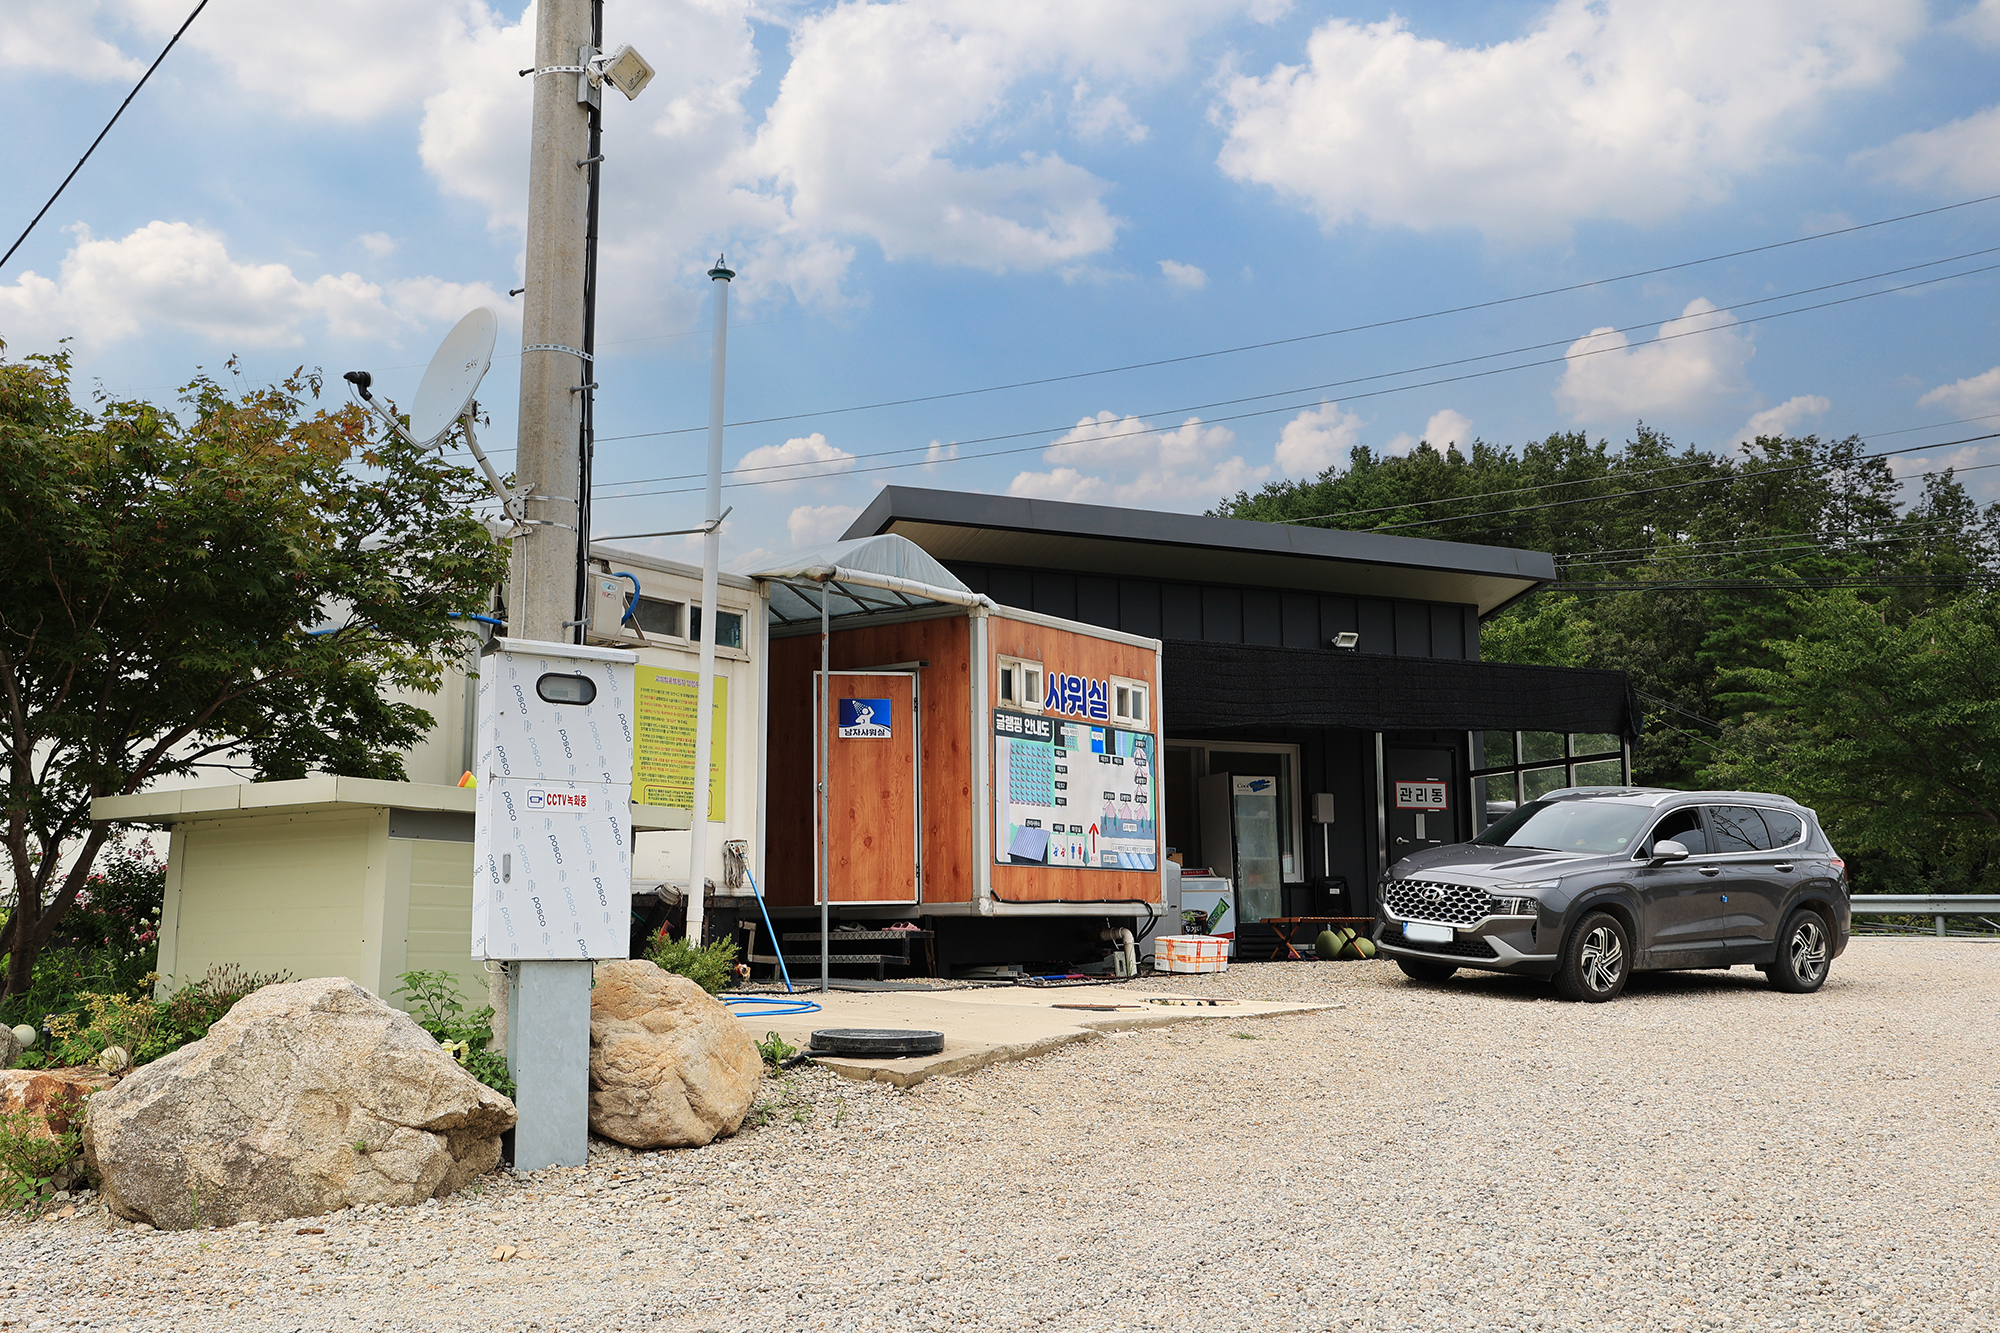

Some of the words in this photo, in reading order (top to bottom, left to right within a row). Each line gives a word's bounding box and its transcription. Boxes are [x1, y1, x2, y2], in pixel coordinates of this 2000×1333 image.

[604, 662, 618, 692] posco
[512, 684, 528, 715] posco
[1045, 672, 1108, 720] 샤워실
[588, 720, 602, 751] posco
[618, 713, 632, 742] posco
[844, 728, 885, 736] 남자샤워실
[996, 714, 1022, 733] 글램핑
[1024, 718, 1050, 736] 안내도
[528, 736, 542, 768] posco
[558, 728, 572, 759] posco
[496, 745, 510, 776] posco
[502, 790, 517, 822] posco
[1400, 787, 1443, 803] 관리동
[579, 825, 594, 855] posco
[608, 816, 622, 846] posco
[517, 844, 532, 874] posco
[548, 834, 562, 864] posco
[562, 886, 578, 916] posco
[592, 876, 607, 906] posco
[500, 906, 514, 938] posco
[531, 896, 546, 927] posco
